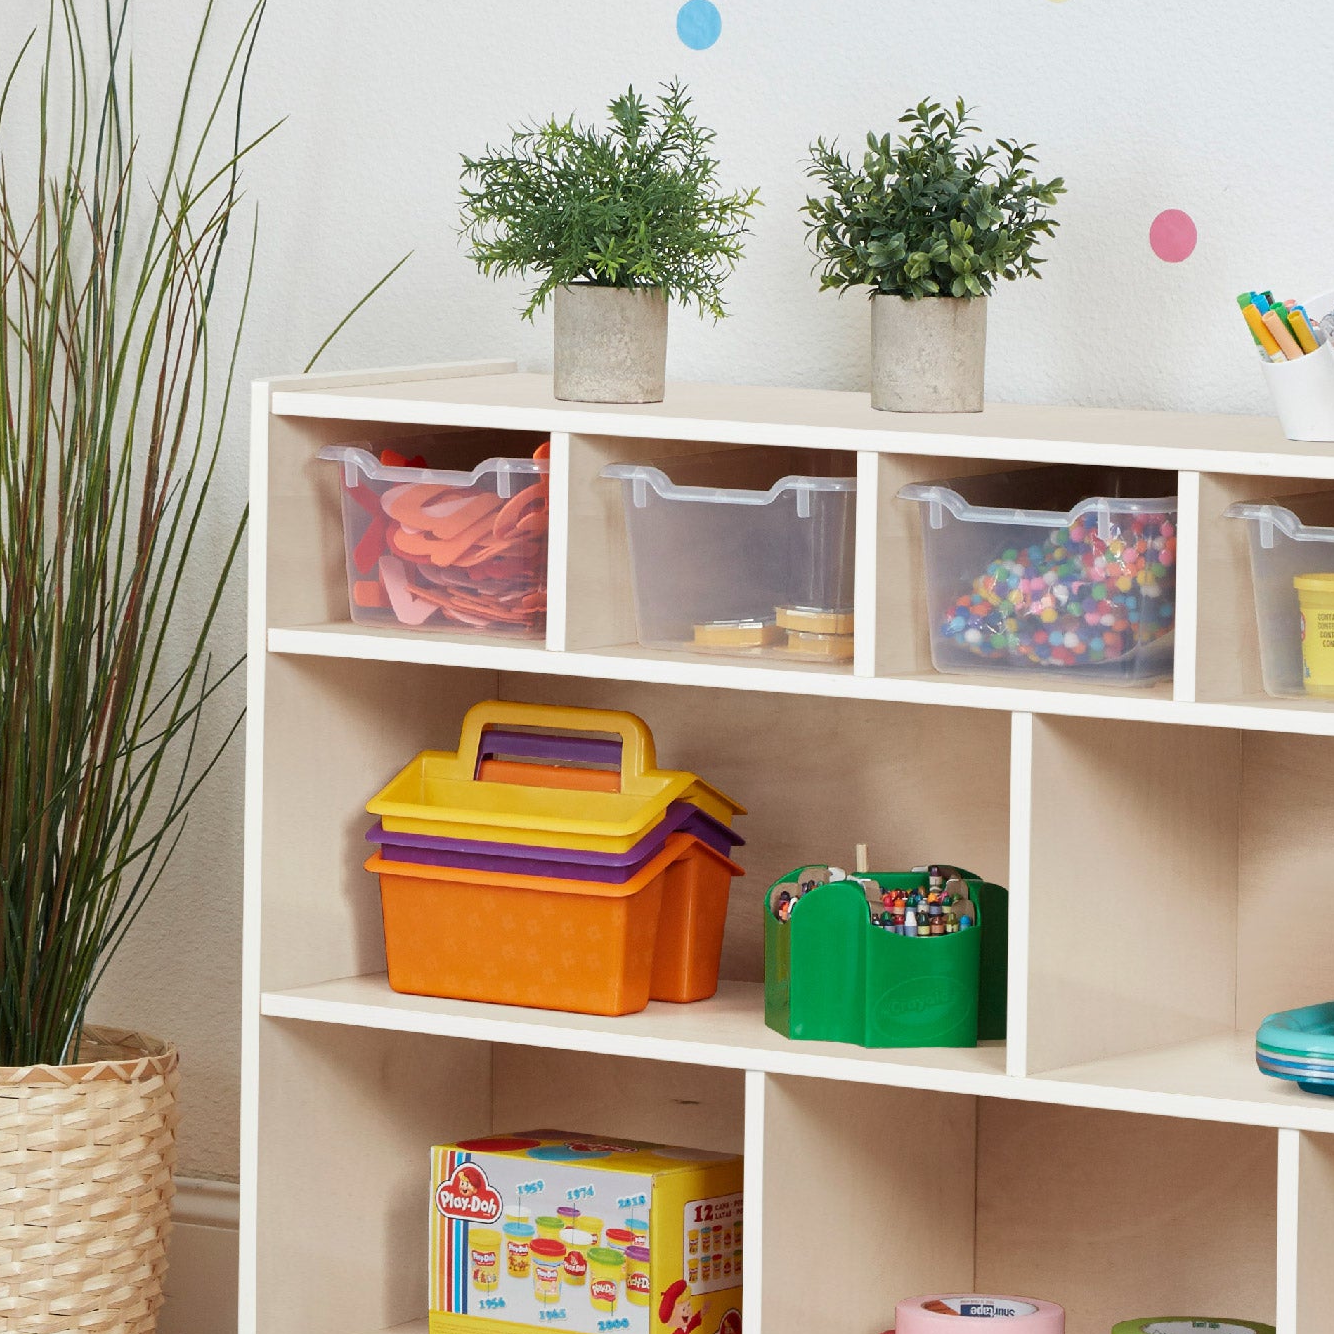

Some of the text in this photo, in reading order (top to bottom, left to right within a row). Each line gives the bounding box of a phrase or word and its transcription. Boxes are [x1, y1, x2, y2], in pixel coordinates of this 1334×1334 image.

[517, 1180, 545, 1195] 1959
[440, 1190, 498, 1215] Play-Doh
[694, 1204, 714, 1223] 12
